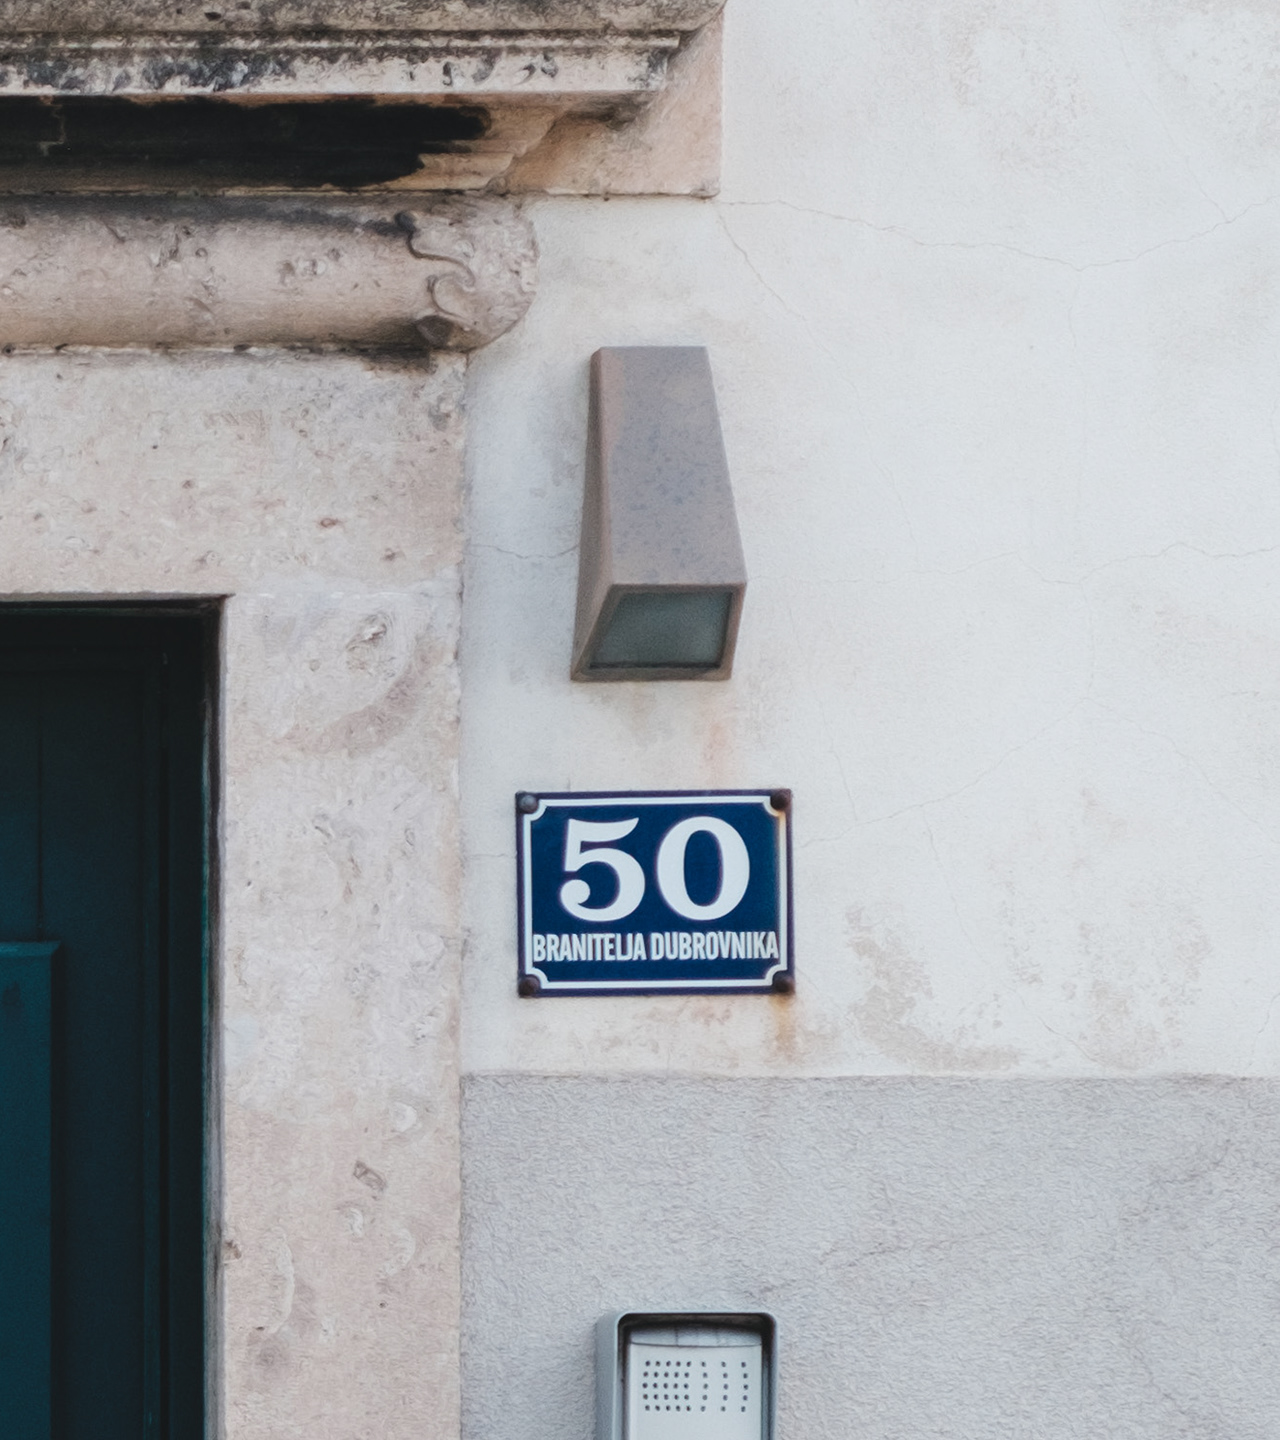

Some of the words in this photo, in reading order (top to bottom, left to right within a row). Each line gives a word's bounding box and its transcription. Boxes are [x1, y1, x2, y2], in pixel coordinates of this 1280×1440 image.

[560, 816, 750, 922] 50
[533, 933, 647, 962] BRANITELJA
[650, 931, 779, 960] DUBROVNIKA
